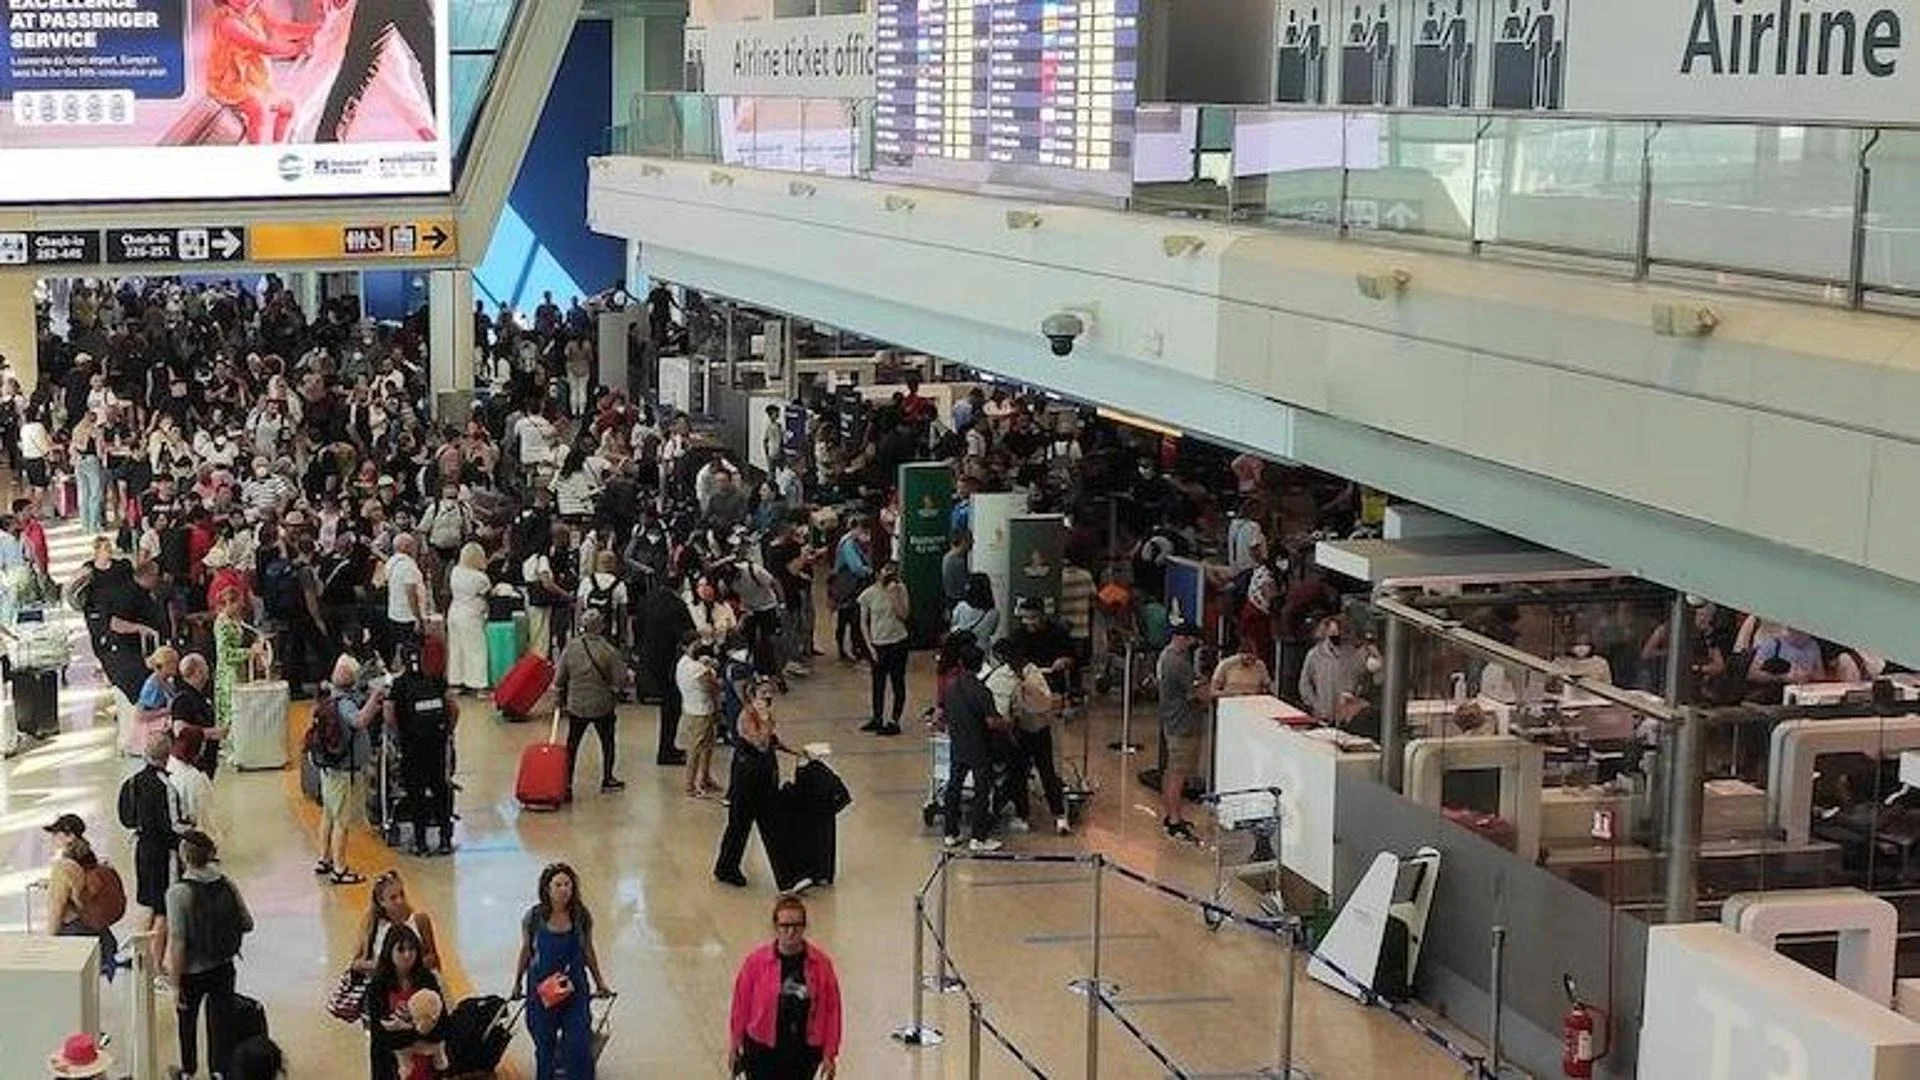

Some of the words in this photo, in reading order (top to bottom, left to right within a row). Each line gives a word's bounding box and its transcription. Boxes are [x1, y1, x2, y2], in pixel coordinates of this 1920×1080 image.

[10, 12, 36, 28] AT
[40, 12, 160, 28] PASSENGER
[11, 32, 98, 48] SERVICE
[1680, 0, 1901, 77] Airline
[733, 38, 779, 76] Airline
[784, 35, 829, 76] ticket
[34, 234, 86, 248] Check-in
[121, 232, 171, 245] Check-in
